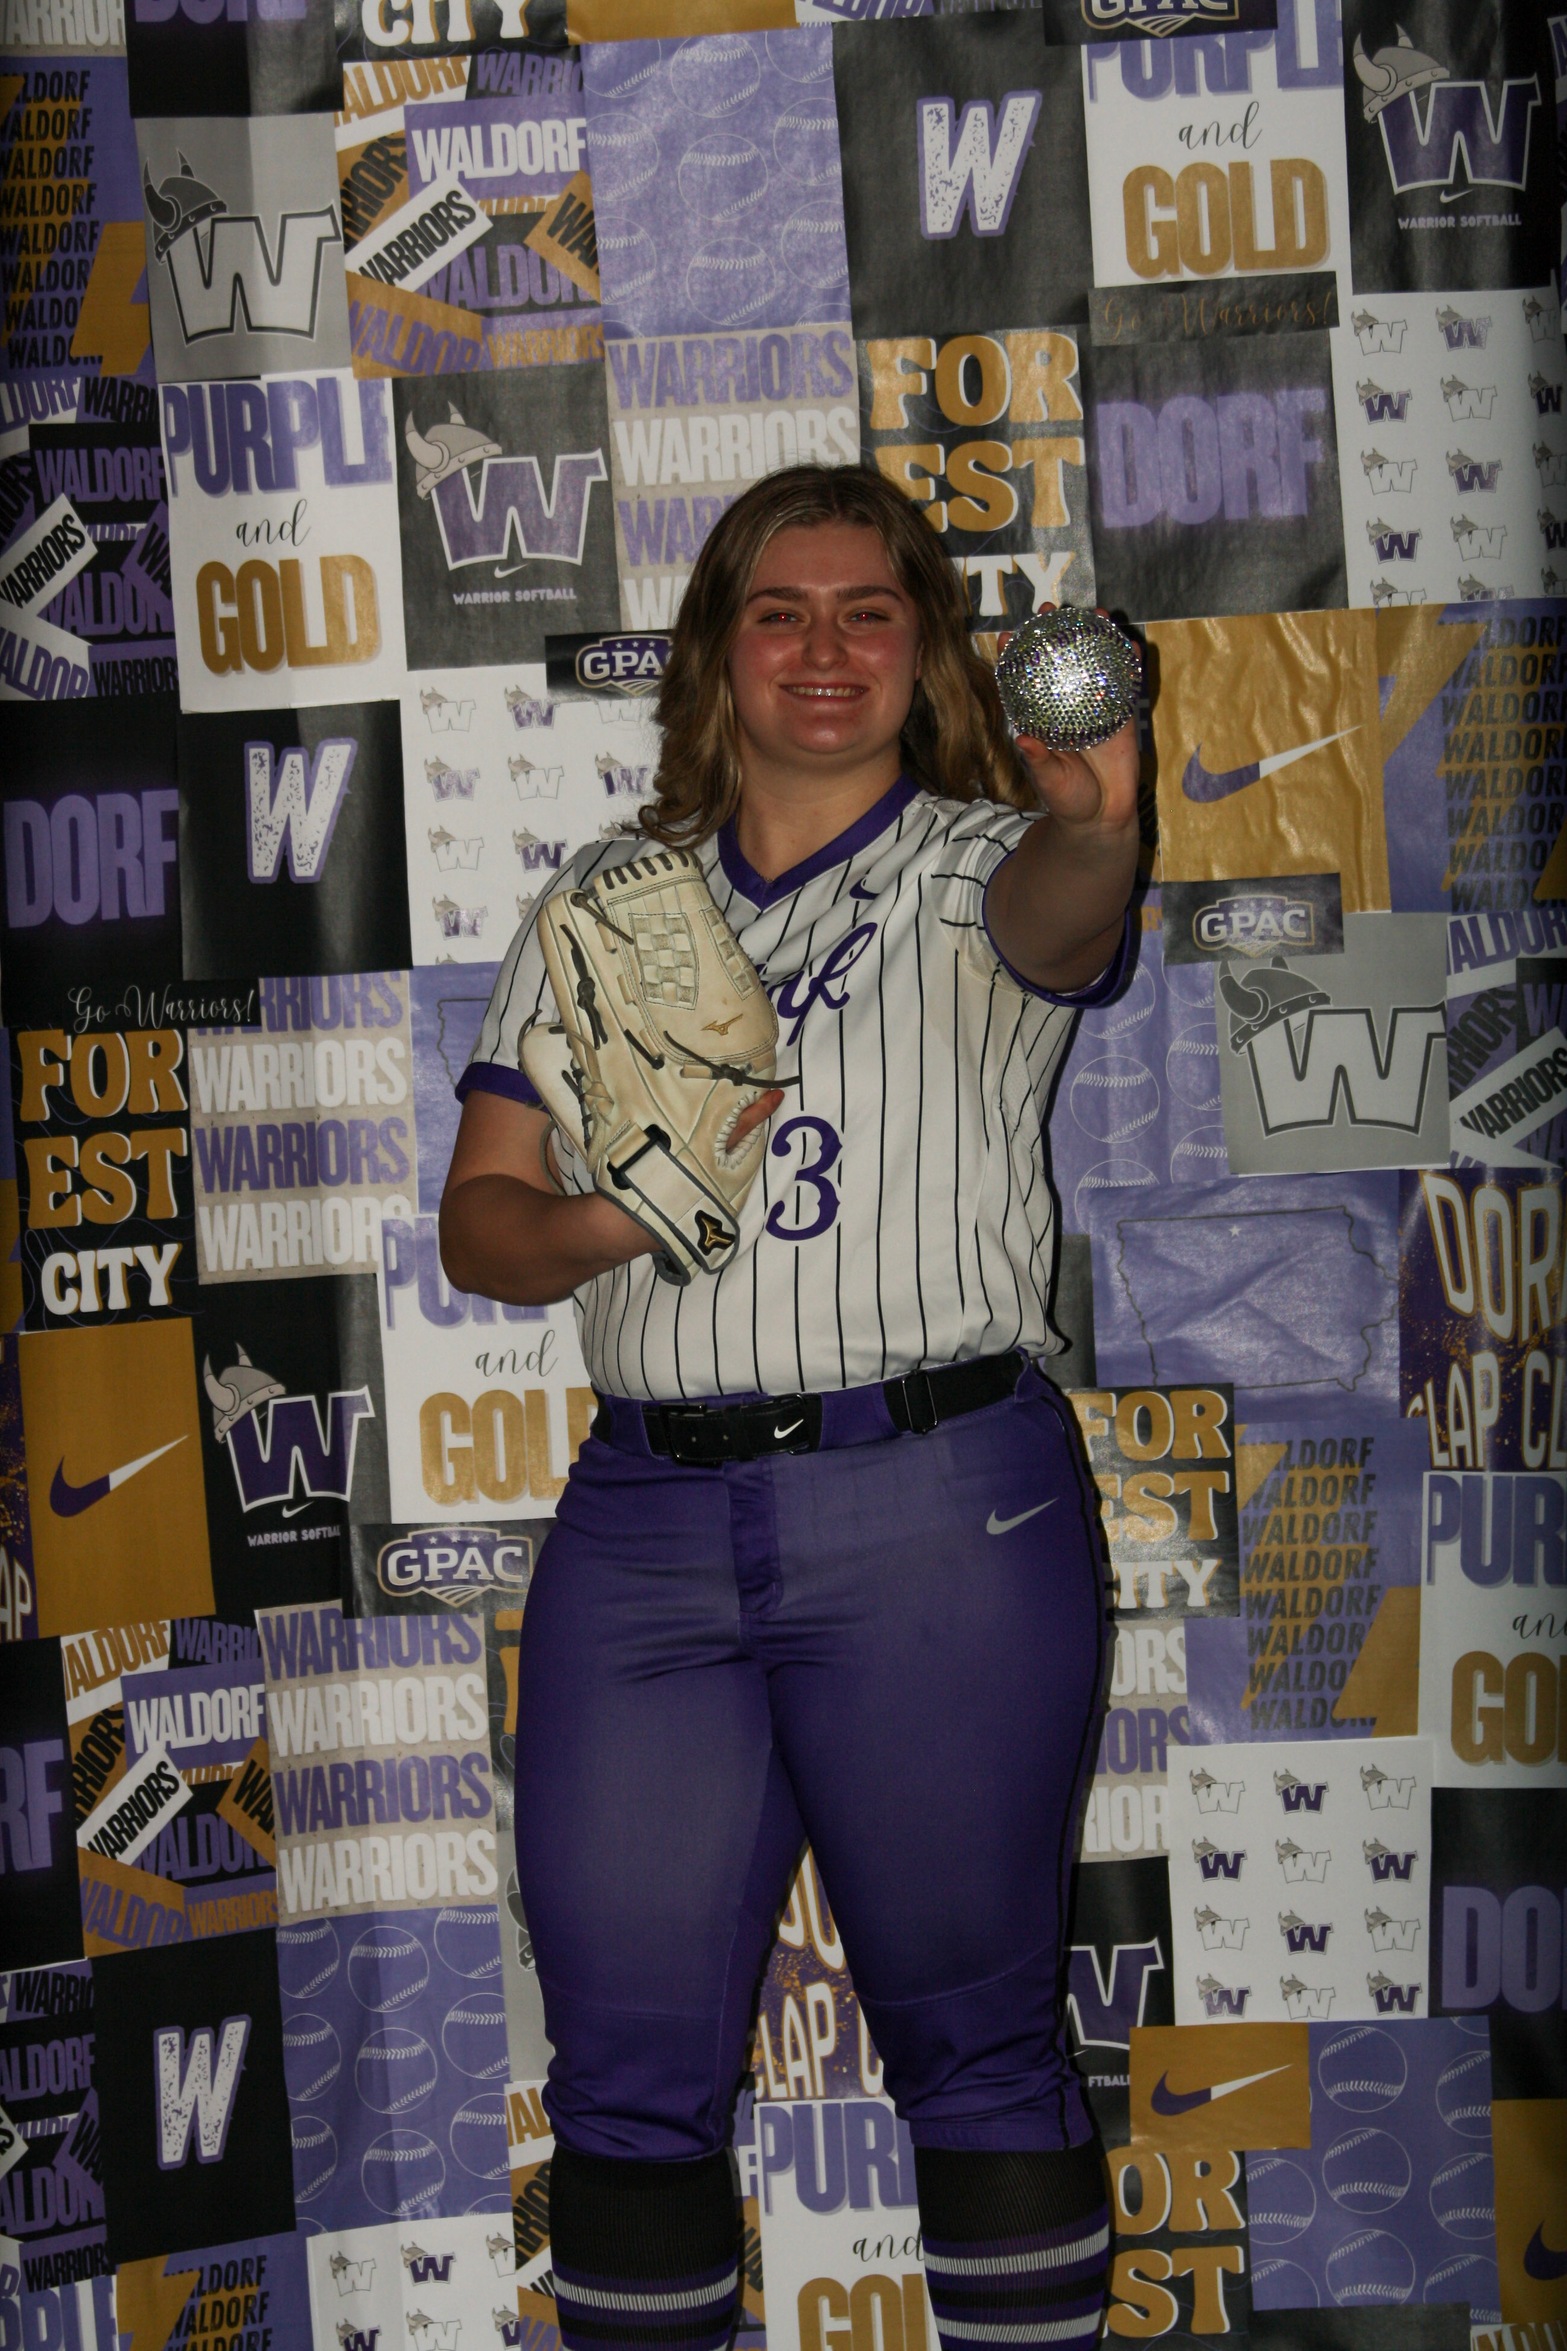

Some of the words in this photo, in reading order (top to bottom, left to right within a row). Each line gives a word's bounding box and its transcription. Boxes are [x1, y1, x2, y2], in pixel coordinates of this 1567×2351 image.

[334, 56, 469, 126] ALDORF
[1178, 101, 1262, 150] and
[411, 117, 587, 183] WALDORF
[917, 90, 1042, 240] W
[1379, 72, 1542, 195] W
[0, 183, 97, 218] WALDORF
[0, 220, 99, 256] WALDORF
[1122, 157, 1332, 281] GOLD
[1397, 216, 1456, 231] WARRIOR
[1460, 213, 1523, 229] SOFTBALL
[3, 258, 95, 294] WALDOR
[5, 296, 84, 332] WALDO
[165, 204, 343, 347] W
[606, 333, 855, 411] WARRIORS
[866, 331, 1084, 430] FOR
[161, 376, 393, 497] PURPLE
[613, 405, 861, 488] WARRIORS
[1097, 387, 1327, 530] DORF
[236, 498, 312, 548] and
[431, 448, 609, 571] W
[196, 554, 383, 676] GOLD
[453, 591, 511, 607] WARRIOR
[515, 587, 578, 602] SOFTBALL
[583, 649, 664, 682] GPA
[244, 737, 358, 884] W
[3, 788, 180, 929] DORF
[1200, 908, 1307, 944] GPAC
[67, 986, 112, 1034] Go
[115, 983, 255, 1030] Warriors!
[17, 1029, 189, 1123] FOR
[192, 1036, 408, 1114] WARRIORS
[1247, 1000, 1447, 1139] W
[24, 1127, 189, 1230] EST
[194, 1116, 411, 1194] WARRIORS
[765, 1116, 843, 1241] 3
[41, 1242, 184, 1316] CITY
[475, 1329, 559, 1378] and
[225, 1384, 376, 1514] W
[1067, 1389, 1232, 1462] FOR
[247, 1529, 299, 1548] WARRIOR
[386, 1546, 524, 1587] GPAC
[1242, 1510, 1378, 1547] WALDORF
[1244, 1547, 1380, 1584] WALDORF
[1114, 1558, 1223, 1610] ITY
[1246, 1584, 1381, 1621] WALDORF
[61, 1620, 170, 1702] ALDORF
[1247, 1621, 1374, 1658] WALDOR
[1249, 1658, 1357, 1695] WALDO
[128, 1683, 266, 1754] WALDORF
[267, 1672, 489, 1759] WARRIORS
[1450, 1650, 1567, 1767] GO
[273, 1751, 494, 1837] WARRIORS
[278, 1828, 499, 1914] WARRIORS
[753, 1981, 838, 2100] LAP
[153, 2013, 252, 2171] W
[1104, 2245, 1245, 2339] ST
